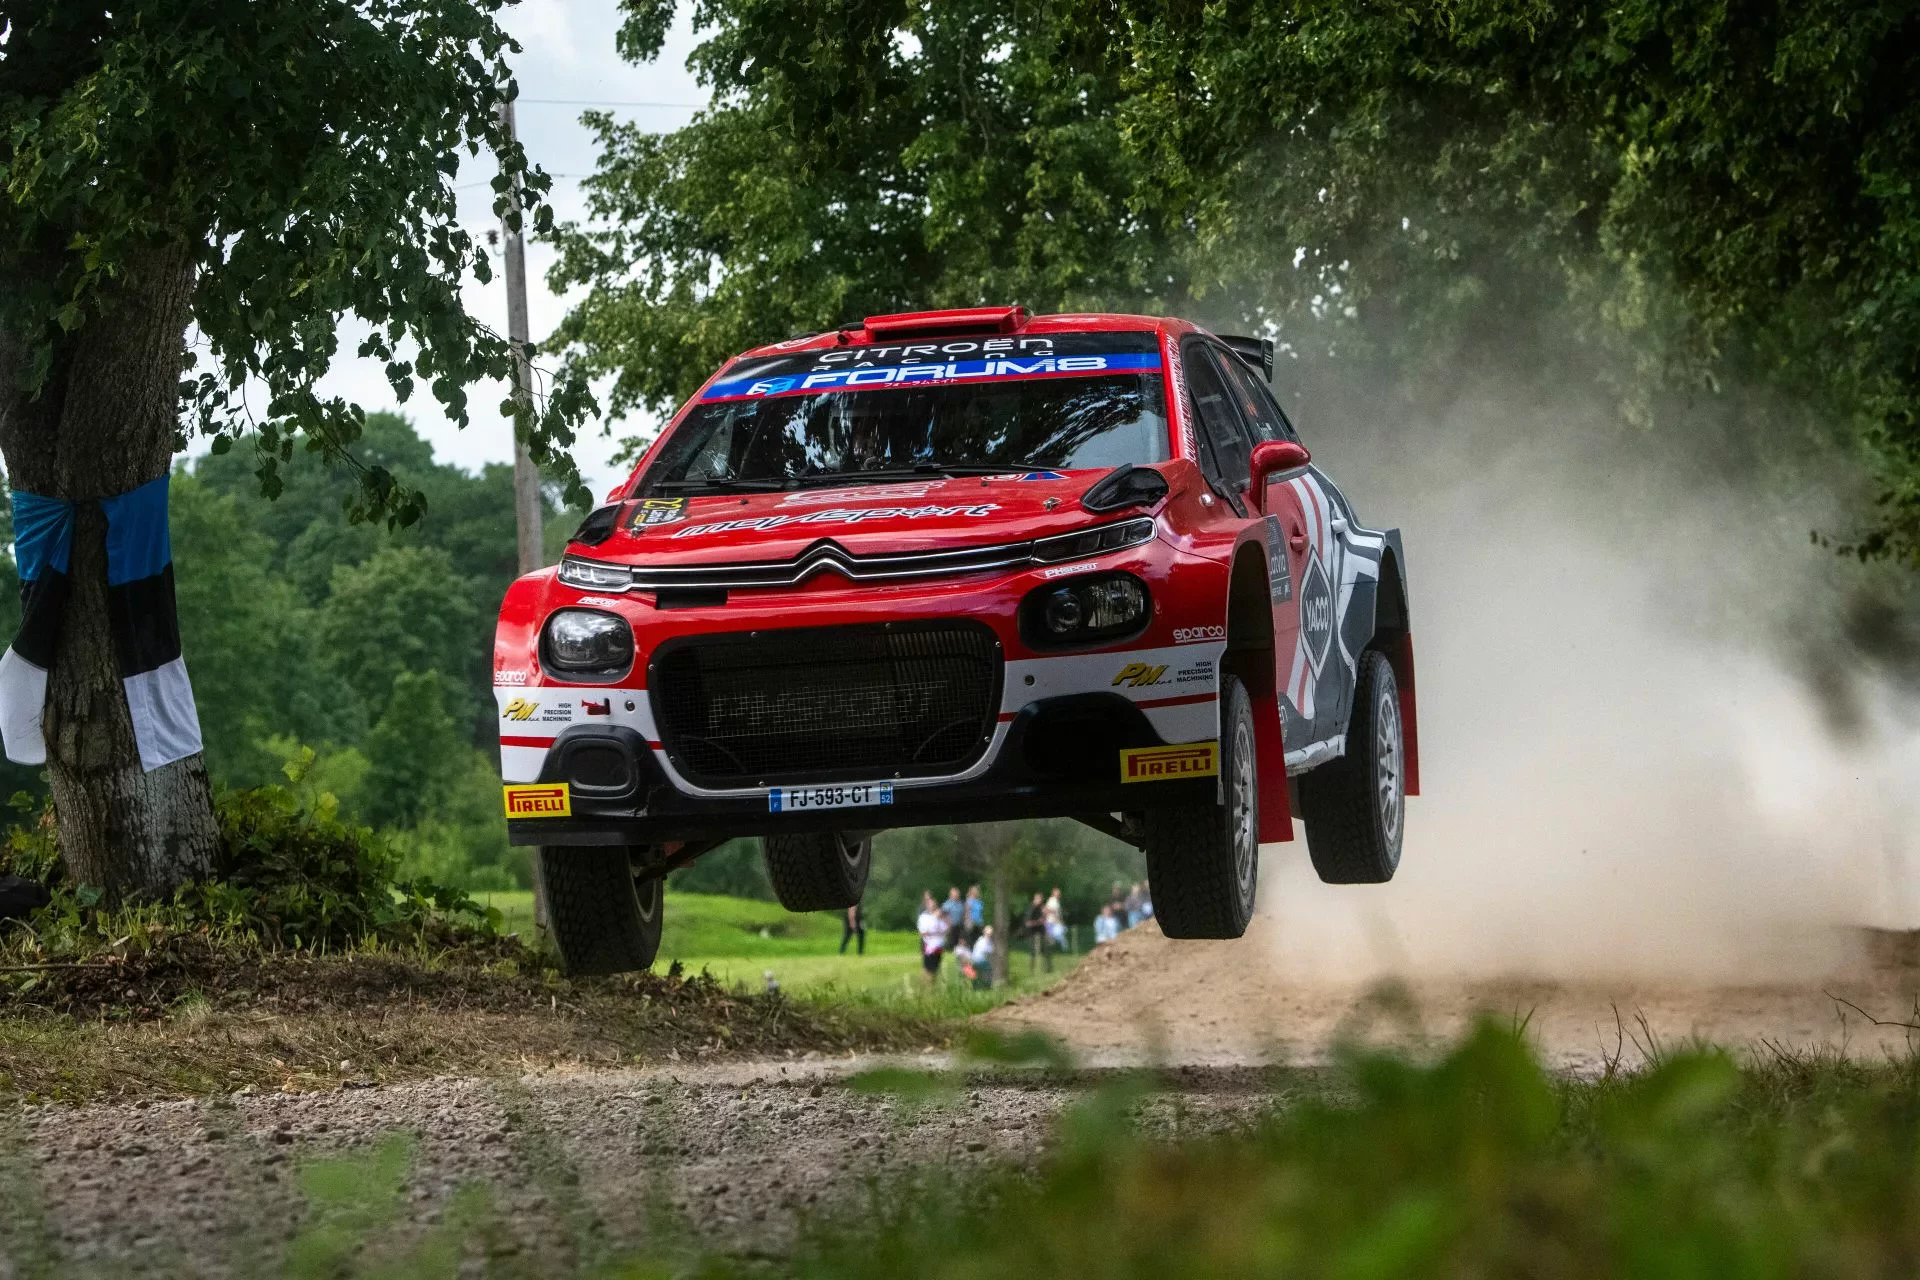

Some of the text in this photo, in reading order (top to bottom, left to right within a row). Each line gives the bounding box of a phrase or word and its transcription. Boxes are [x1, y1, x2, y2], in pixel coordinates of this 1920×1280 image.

[811, 350, 1054, 372] RACING
[800, 357, 1108, 389] FORUM8
[1044, 562, 1098, 578] PHSPORT
[1305, 596, 1329, 631] YACCO
[1173, 625, 1224, 643] sparco
[494, 670, 527, 685] sparco
[1111, 662, 1170, 688] PM
[1176, 674, 1214, 683] MACHINING
[1178, 667, 1213, 676] PRECISION
[502, 697, 540, 721] PM
[1128, 749, 1211, 777] PIRELLI
[508, 788, 565, 812] PIRELLI
[790, 785, 873, 807] FJ-593-CT
[881, 794, 891, 804] 52
